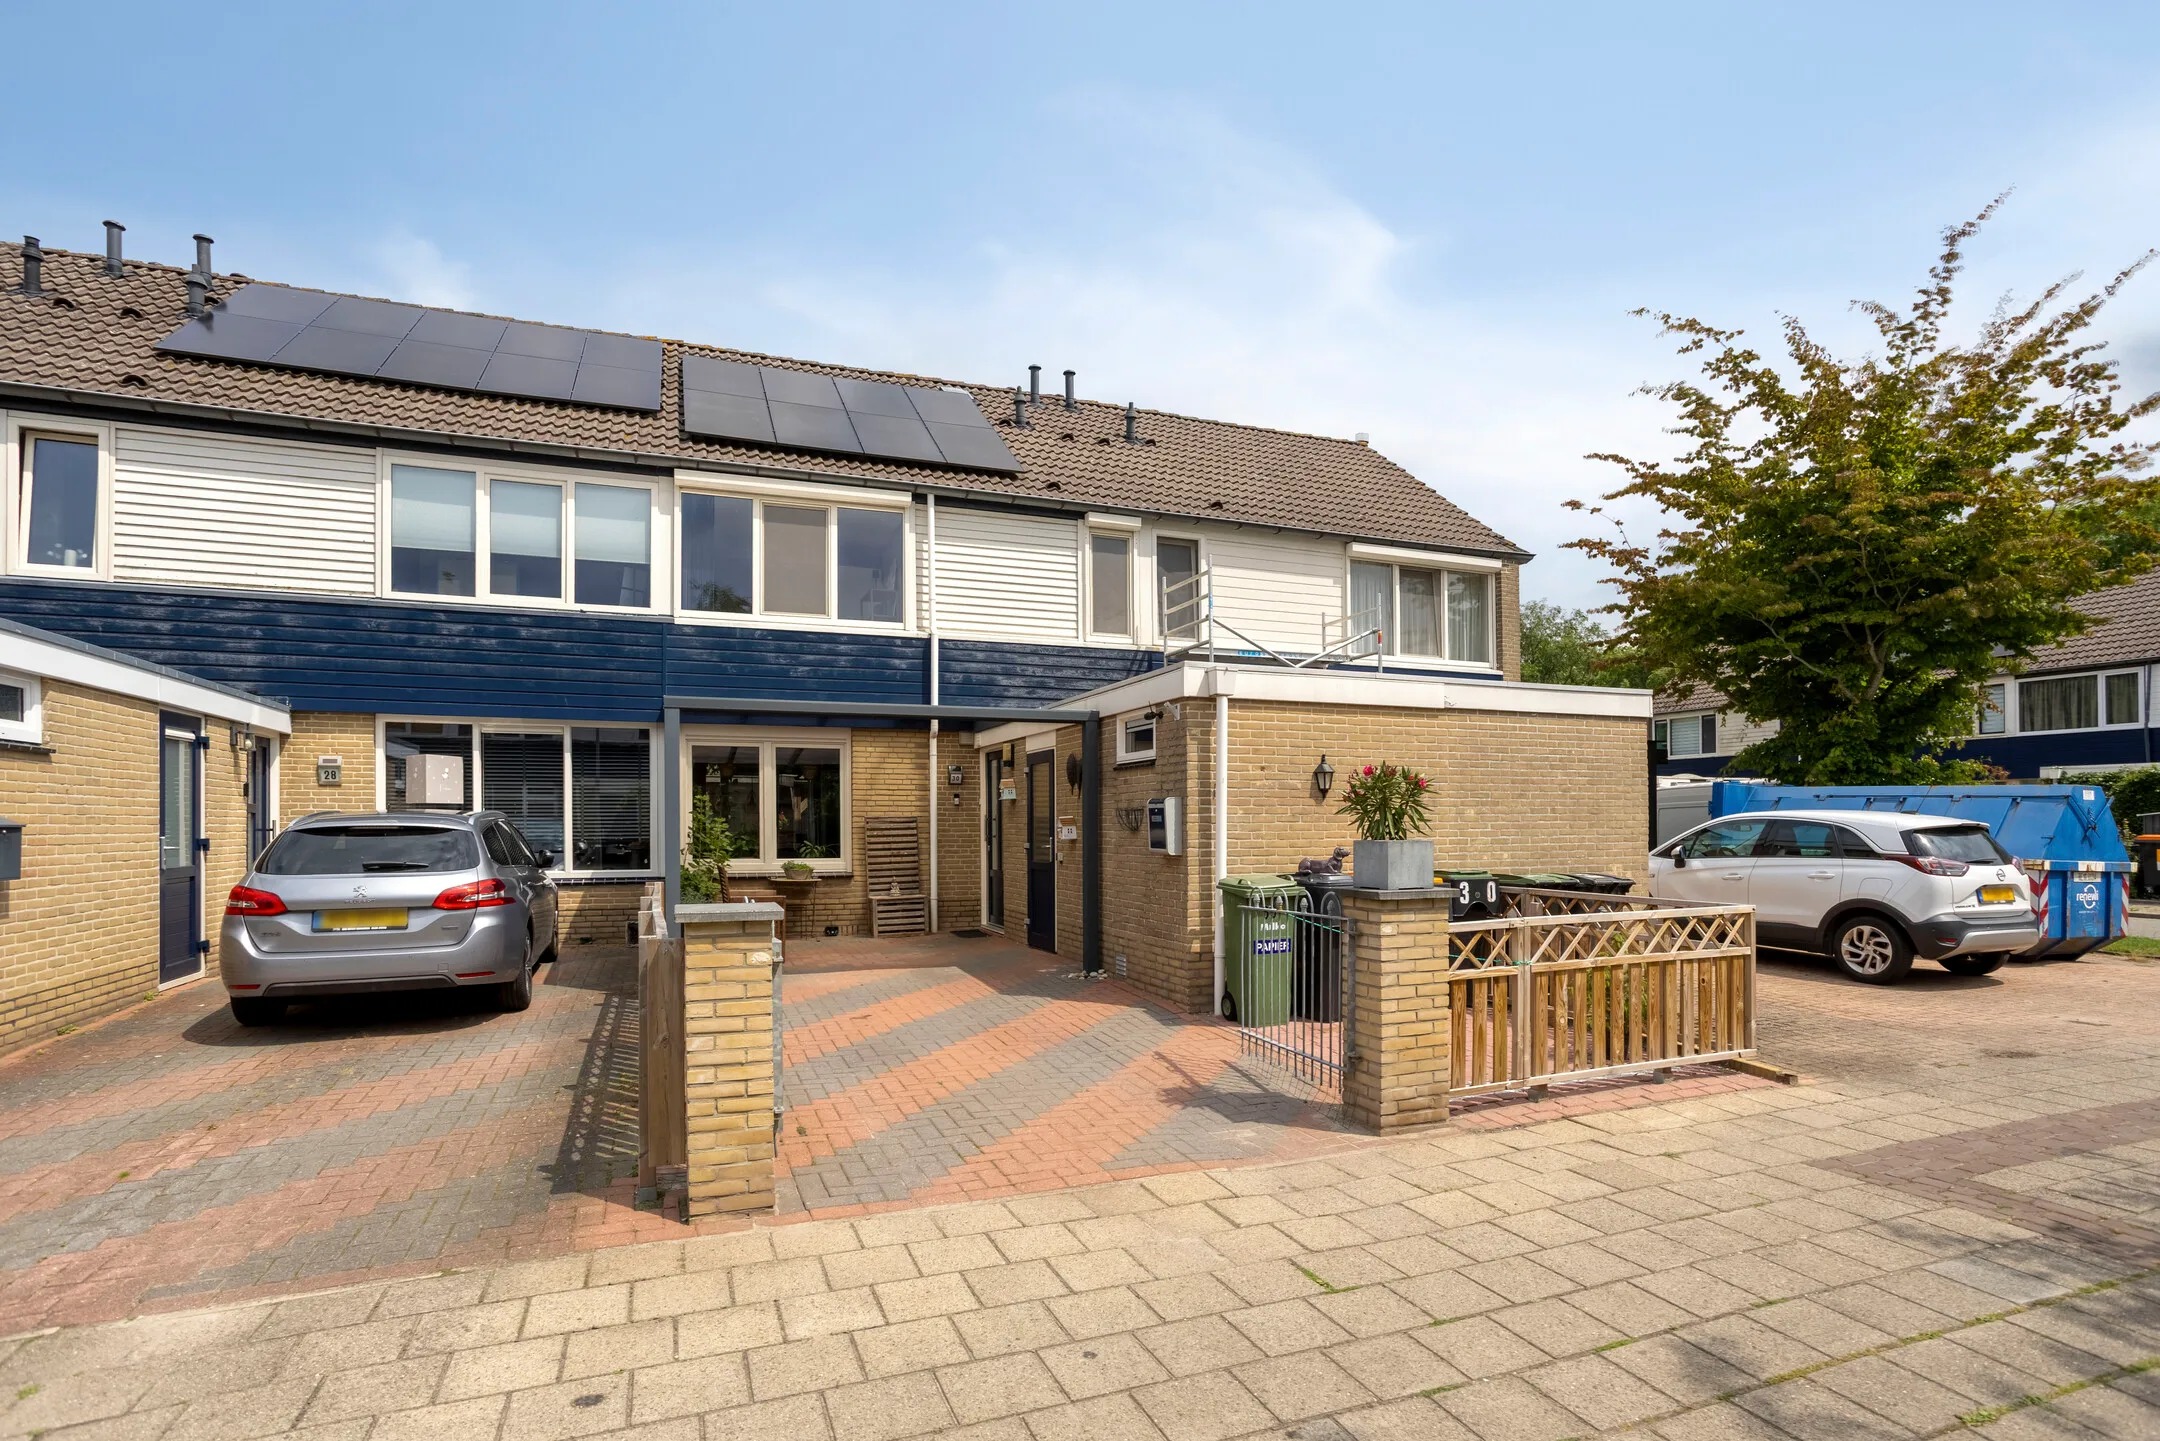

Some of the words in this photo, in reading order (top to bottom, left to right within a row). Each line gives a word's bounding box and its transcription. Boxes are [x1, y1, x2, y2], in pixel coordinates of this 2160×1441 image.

[324, 770, 336, 780] 28
[1460, 881, 1470, 904] 3
[1487, 881, 1497, 903] 0
[1256, 941, 1290, 951] PAPIER
